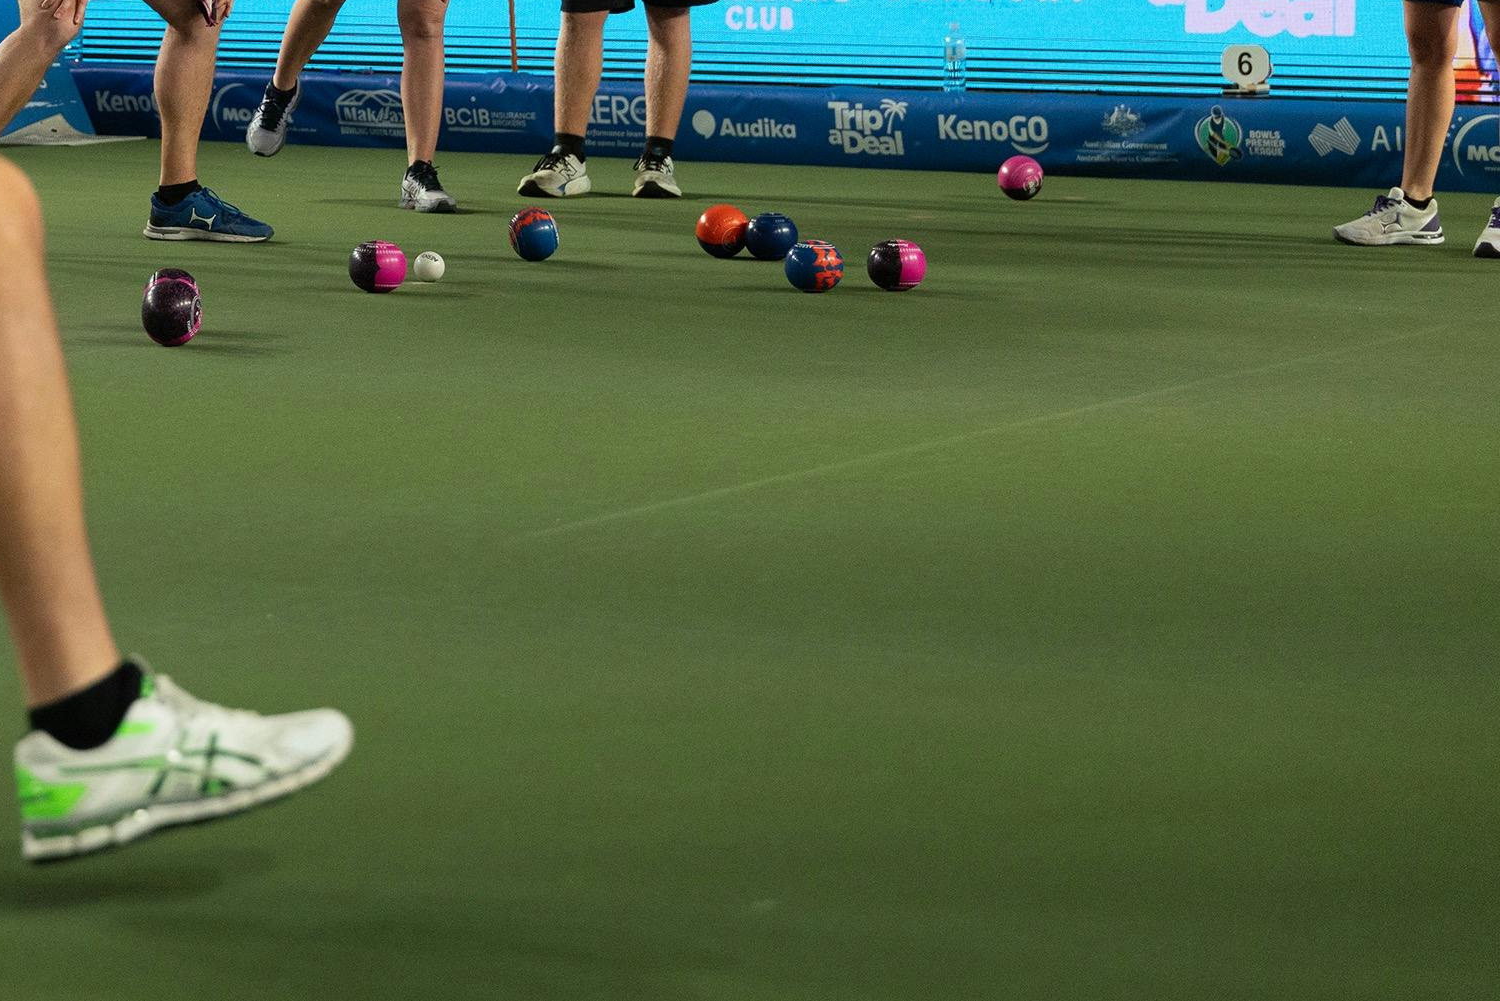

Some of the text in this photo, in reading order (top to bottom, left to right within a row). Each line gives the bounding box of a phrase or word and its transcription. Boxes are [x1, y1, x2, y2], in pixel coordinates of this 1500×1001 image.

[725, 5, 794, 31] CLUB
[1237, 51, 1254, 76] 6
[444, 107, 490, 126] BCIB
[589, 95, 646, 126] ERO
[828, 101, 883, 133] Trip
[719, 118, 797, 139] Audika
[937, 114, 1048, 143] KenoGO
[1249, 130, 1281, 139] BOWLS
[1245, 138, 1286, 149] PREMIER
